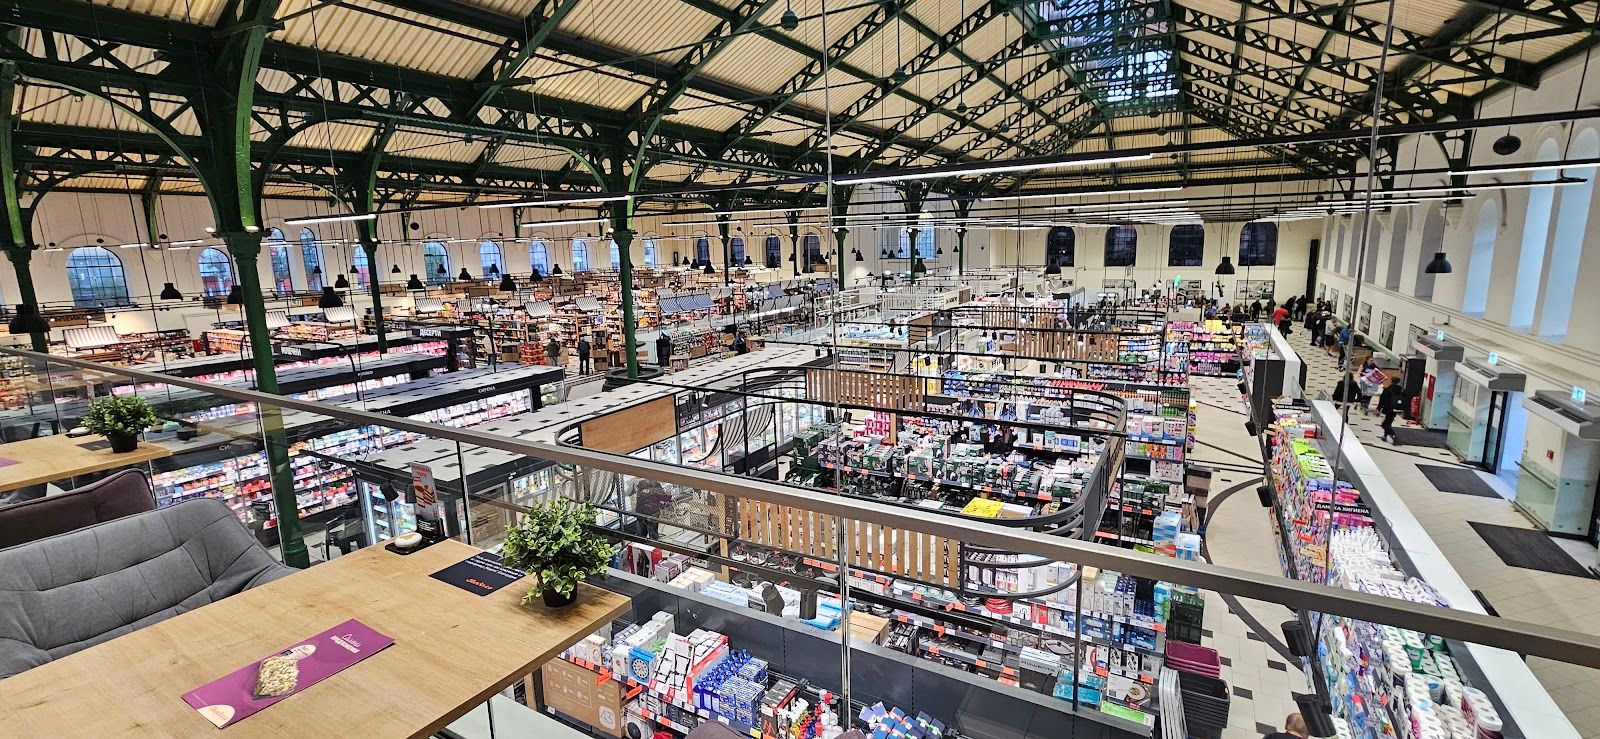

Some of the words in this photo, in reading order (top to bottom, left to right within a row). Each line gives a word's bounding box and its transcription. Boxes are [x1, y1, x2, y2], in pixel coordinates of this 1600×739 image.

[419, 328, 442, 338] ДЕСЕРТИ
[1316, 503, 1341, 512] ДАМКА
[1341, 506, 1370, 514] ХИГИЕНА
